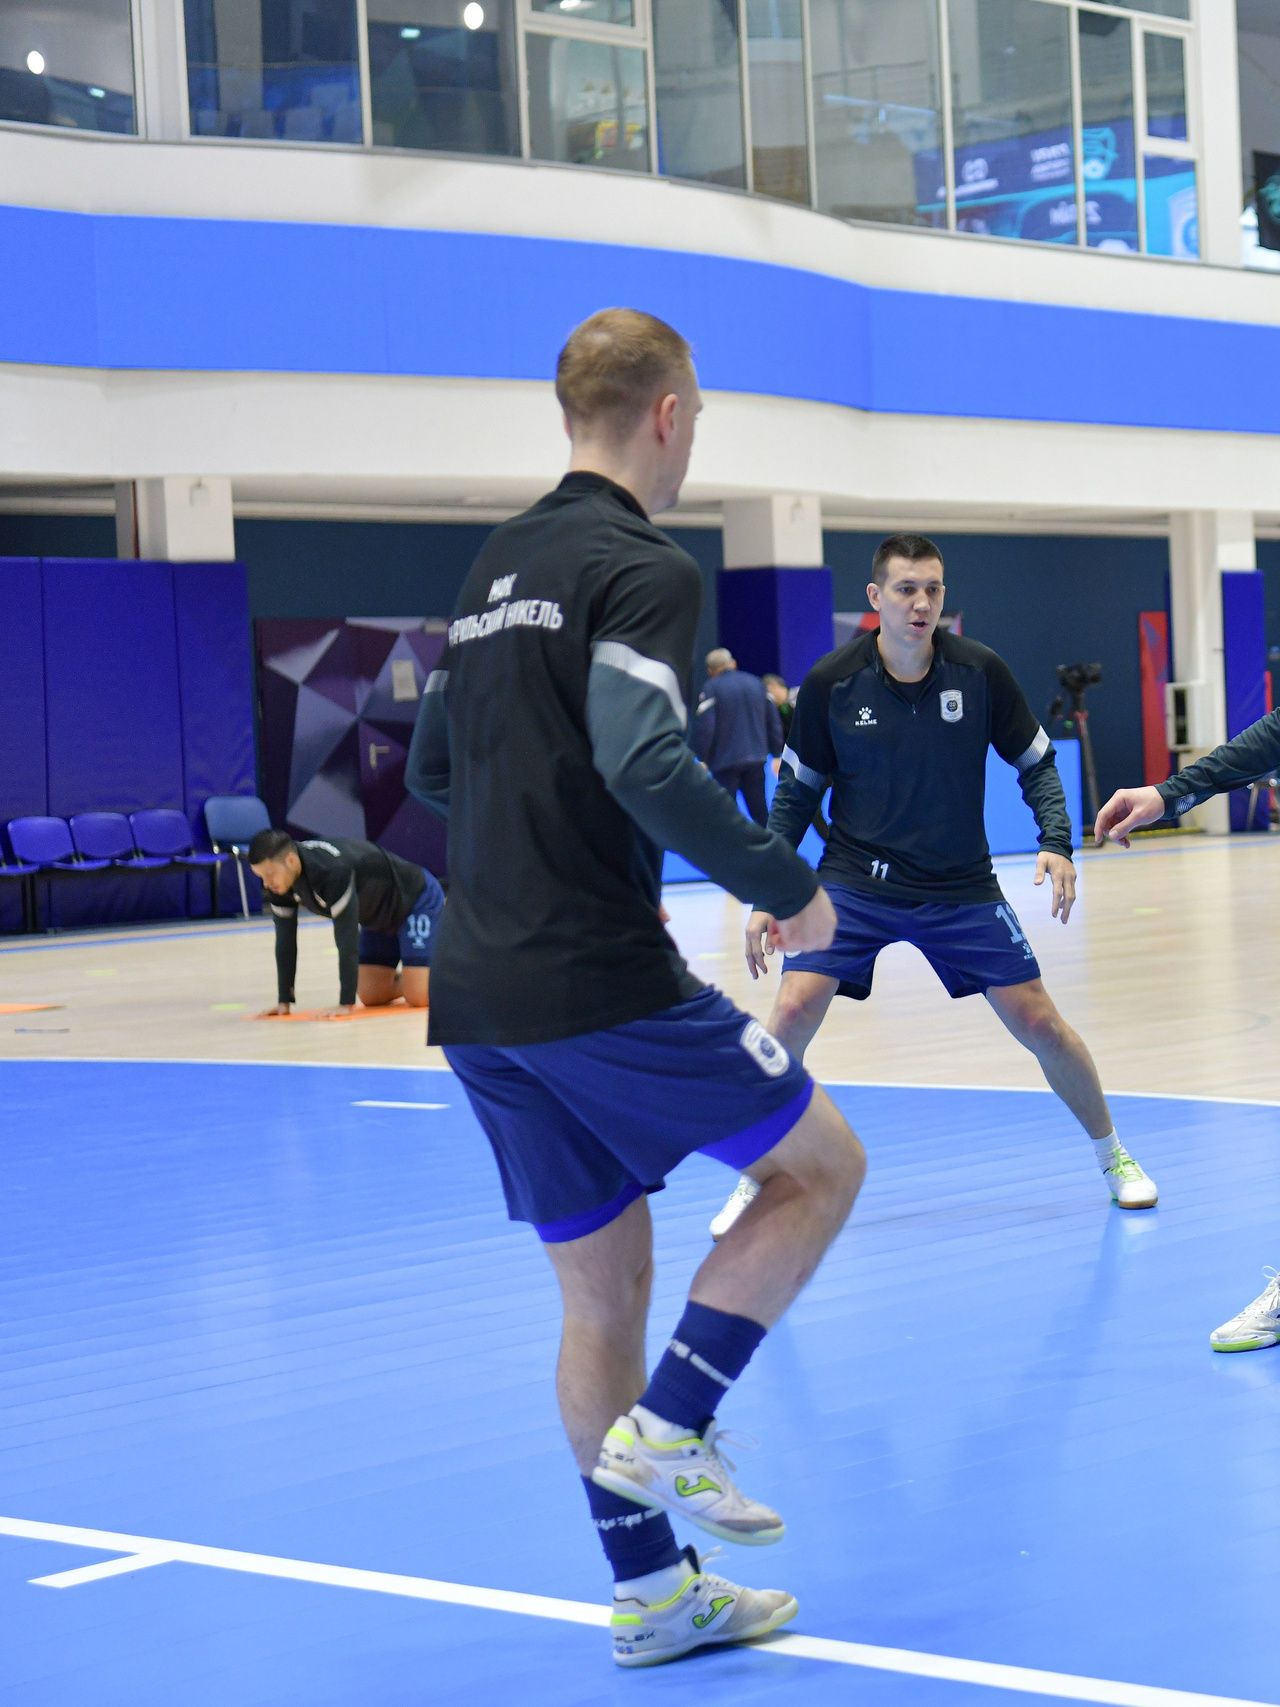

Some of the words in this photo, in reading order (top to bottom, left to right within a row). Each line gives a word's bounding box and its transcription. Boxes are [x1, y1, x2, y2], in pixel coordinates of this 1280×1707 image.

[504, 599, 563, 630] НИКЕЛЬ
[855, 718, 878, 726] KELME
[870, 859, 890, 881] 11
[407, 913, 431, 939] 10
